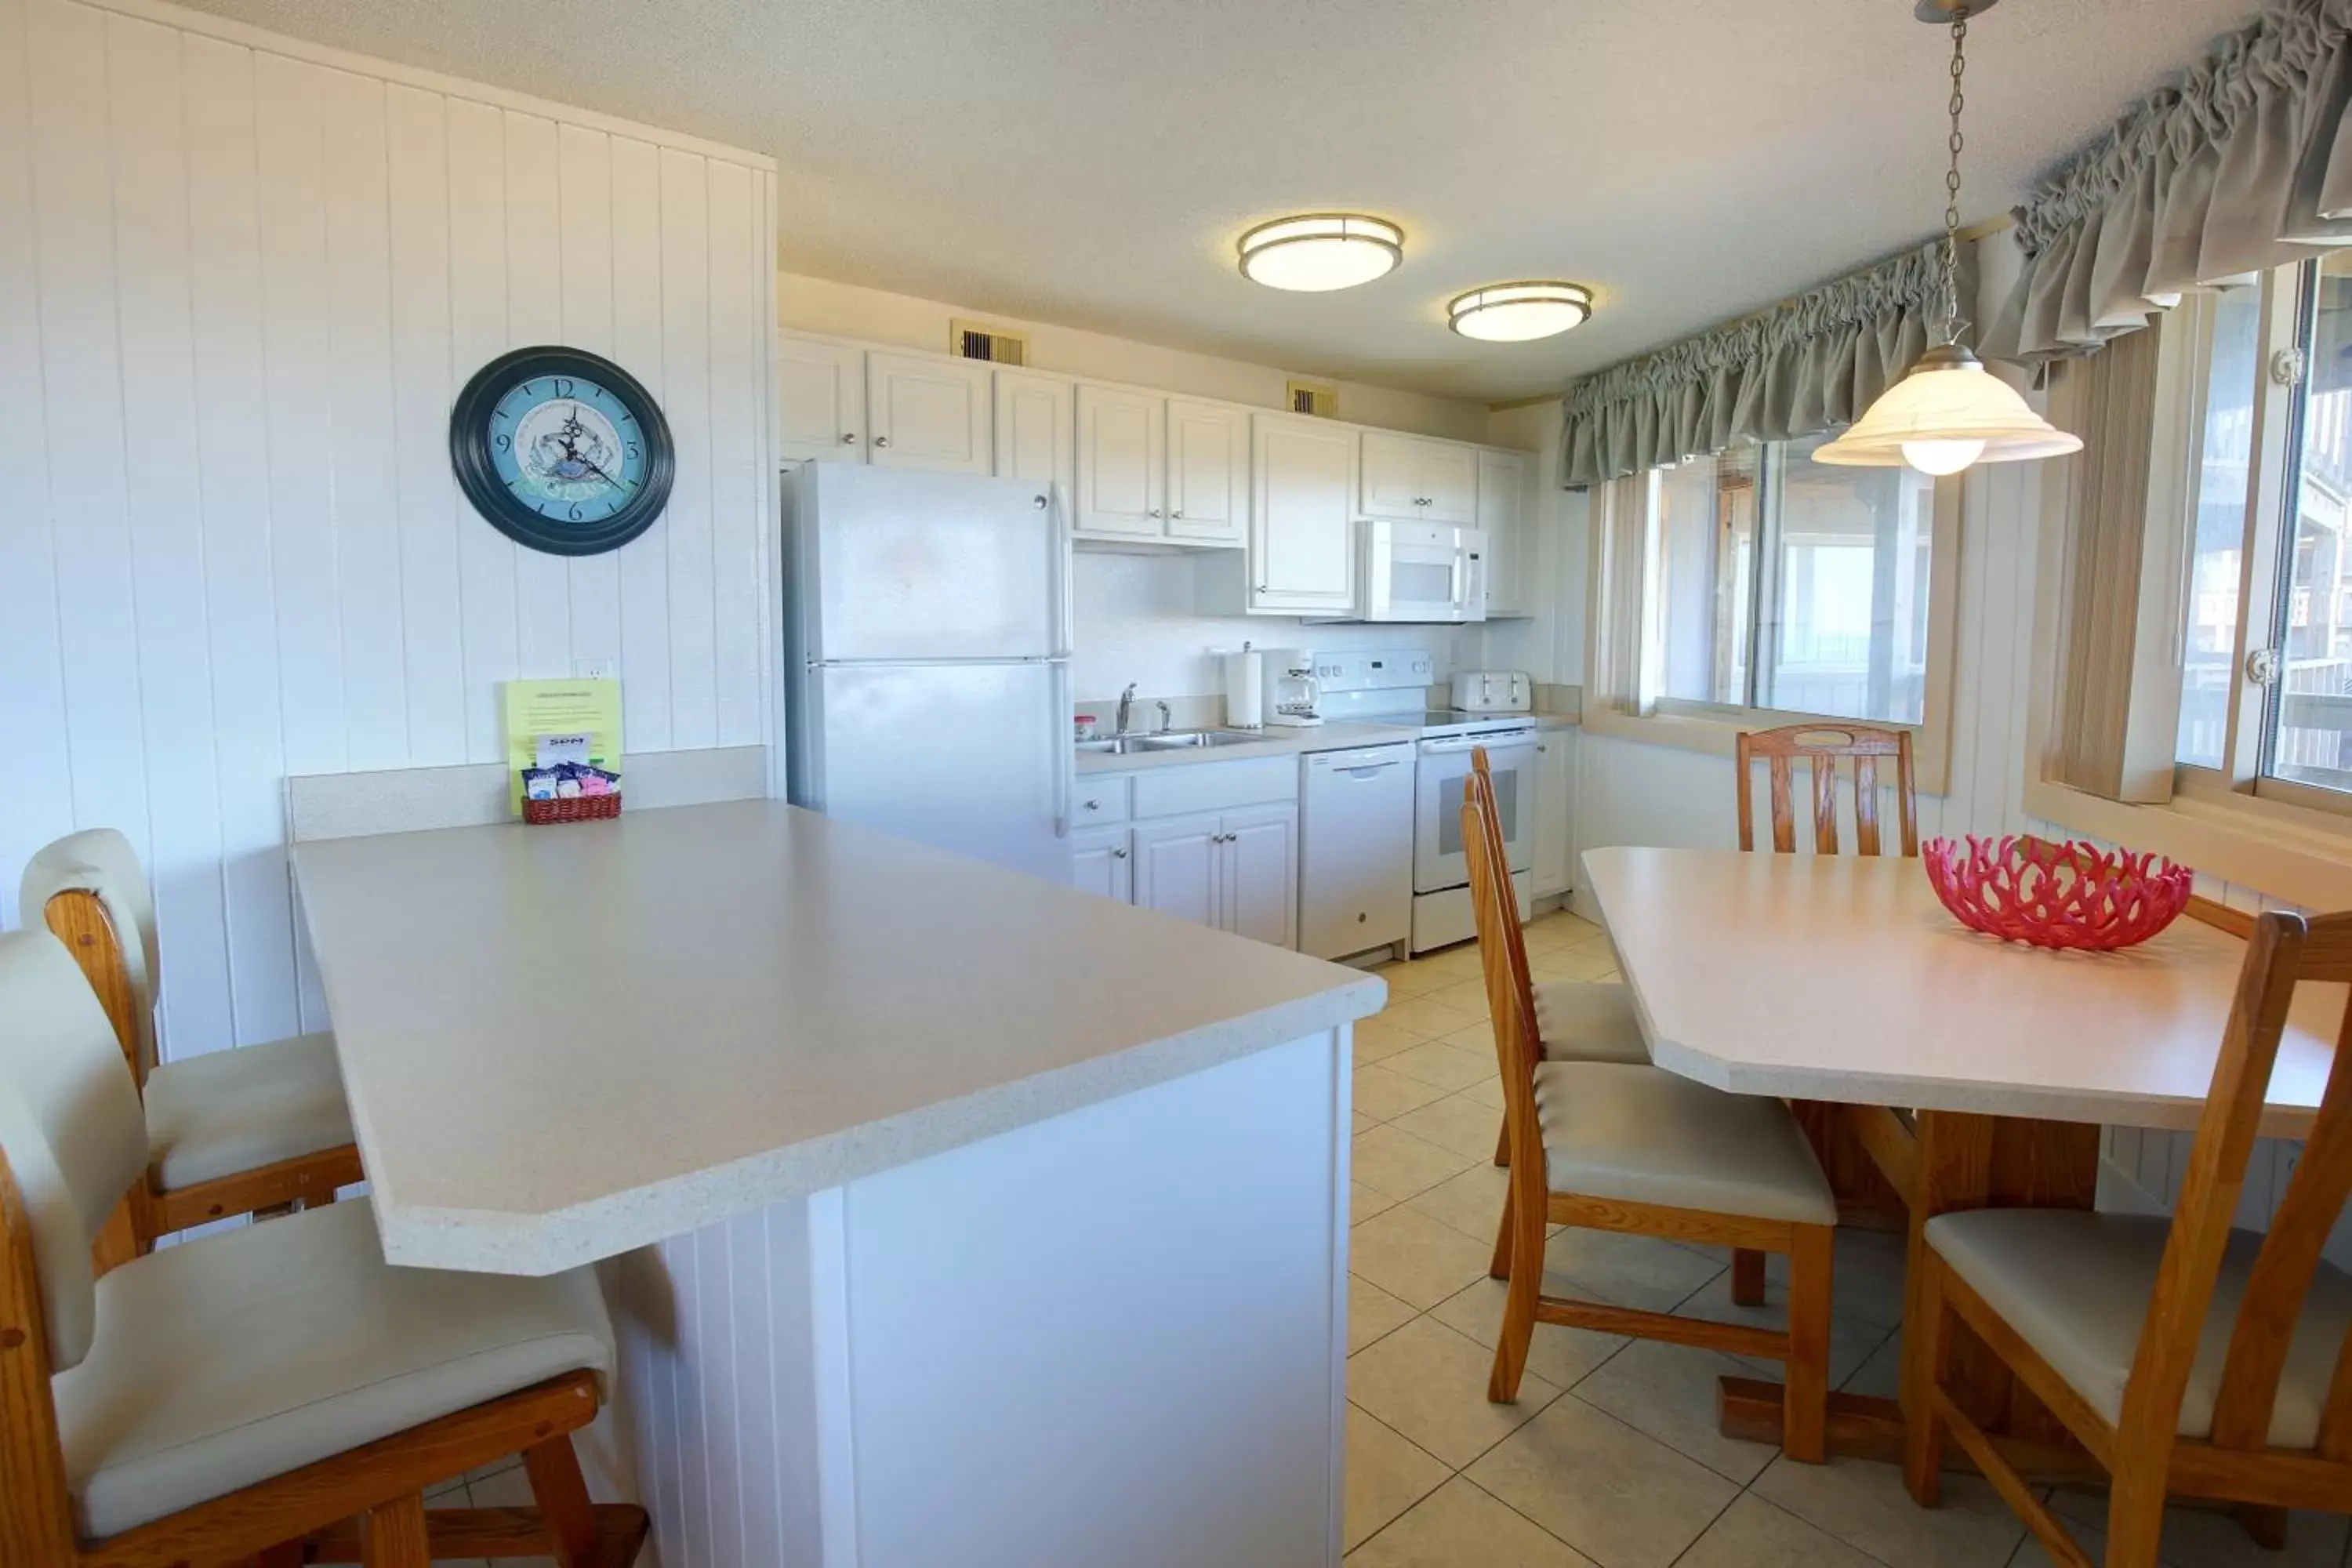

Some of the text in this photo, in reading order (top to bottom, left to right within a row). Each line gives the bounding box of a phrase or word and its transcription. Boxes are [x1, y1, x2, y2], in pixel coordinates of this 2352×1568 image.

[553, 379, 575, 399] 12
[496, 434, 511, 454] 9
[627, 441, 639, 459] 3
[569, 501, 583, 521] 6
